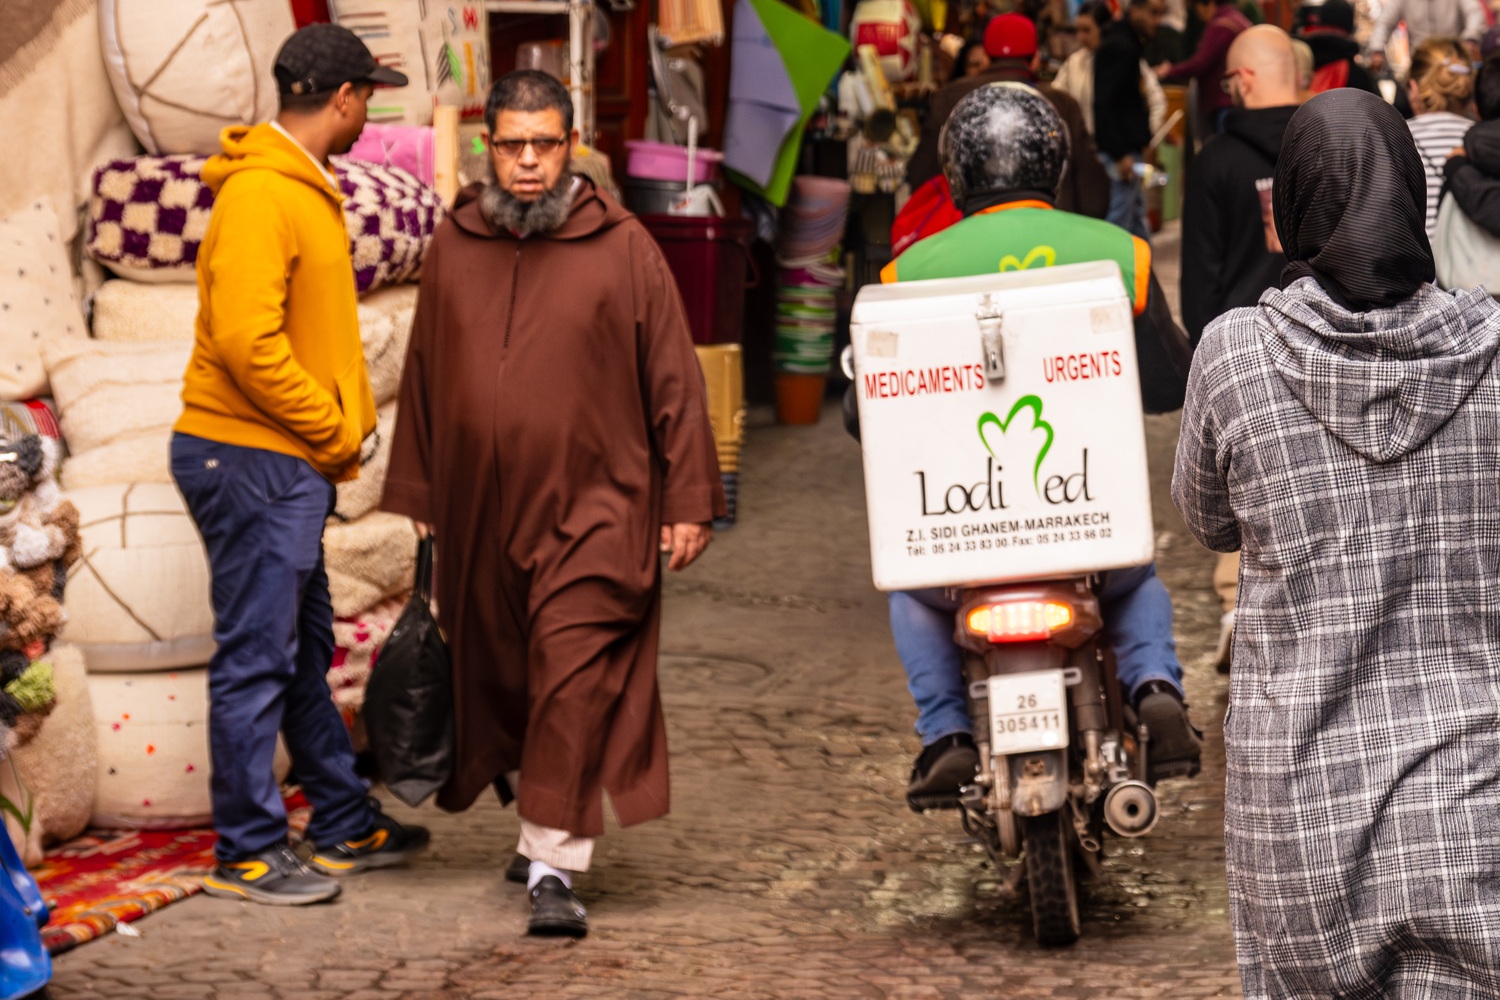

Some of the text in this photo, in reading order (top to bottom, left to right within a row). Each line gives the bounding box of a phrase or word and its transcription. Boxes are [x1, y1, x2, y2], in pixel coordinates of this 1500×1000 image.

[864, 350, 1122, 400] MEDICAMENTS URGENTS
[930, 526, 957, 541] SIDI
[949, 541, 961, 553] 24
[964, 540, 977, 551] 33
[1018, 694, 1037, 709] 26
[996, 714, 1059, 734] 305411
